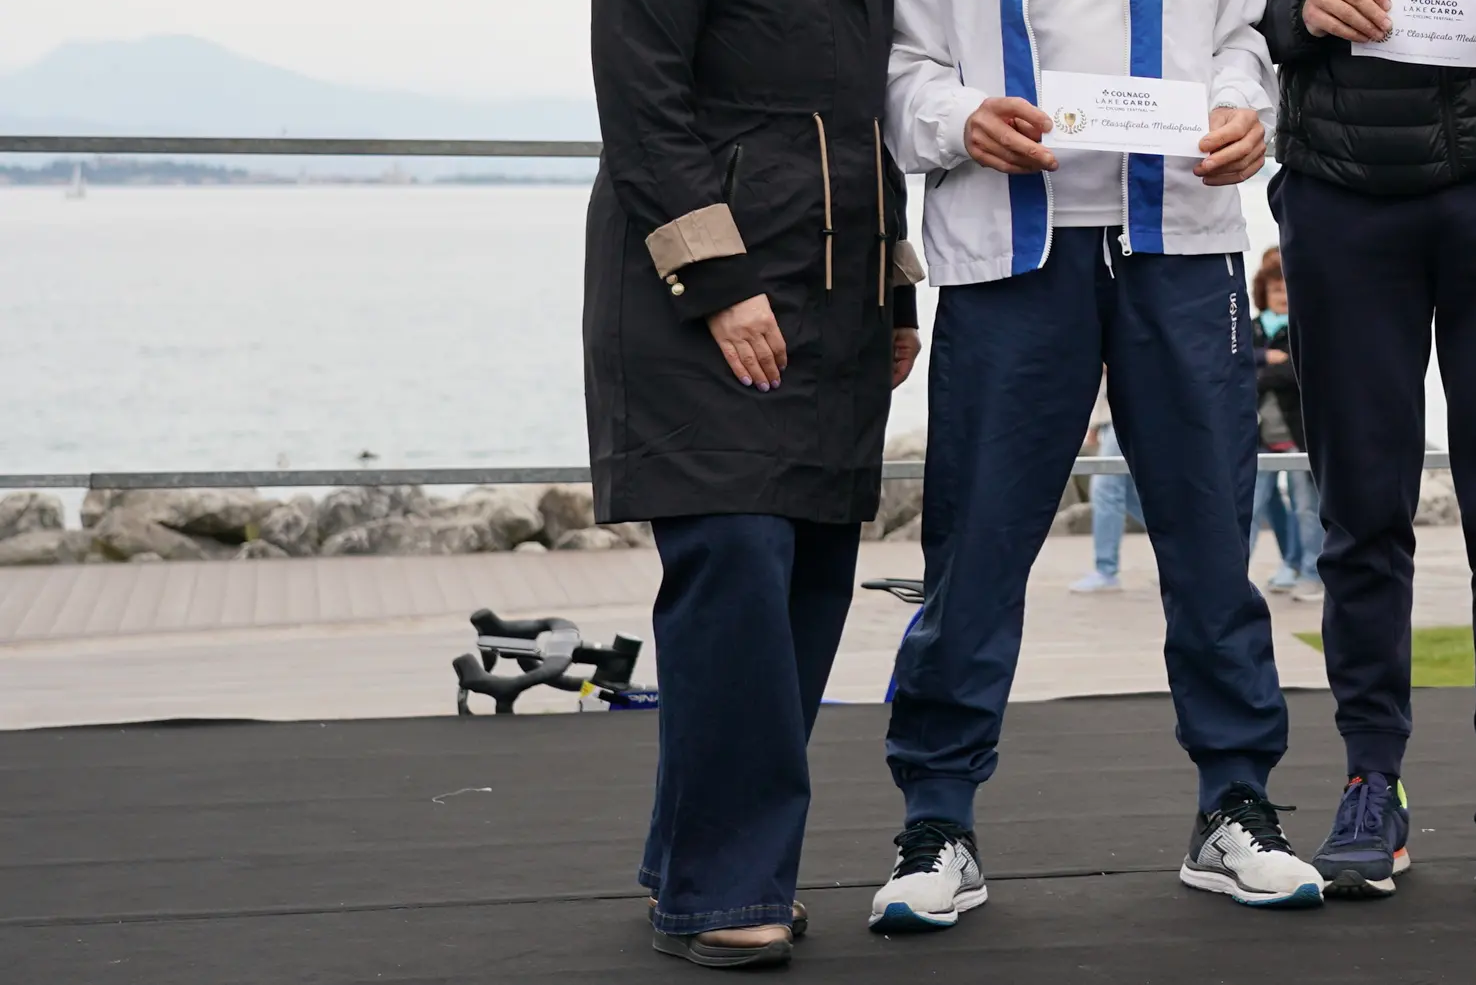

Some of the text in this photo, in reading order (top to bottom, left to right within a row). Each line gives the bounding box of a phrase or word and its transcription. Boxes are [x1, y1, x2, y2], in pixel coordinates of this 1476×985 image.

[1403, 5, 1464, 16] LAKE GARDA
[1110, 90, 1150, 99] COLNAGO
[1123, 99, 1158, 107] GARDA
[1229, 292, 1238, 355] macron
